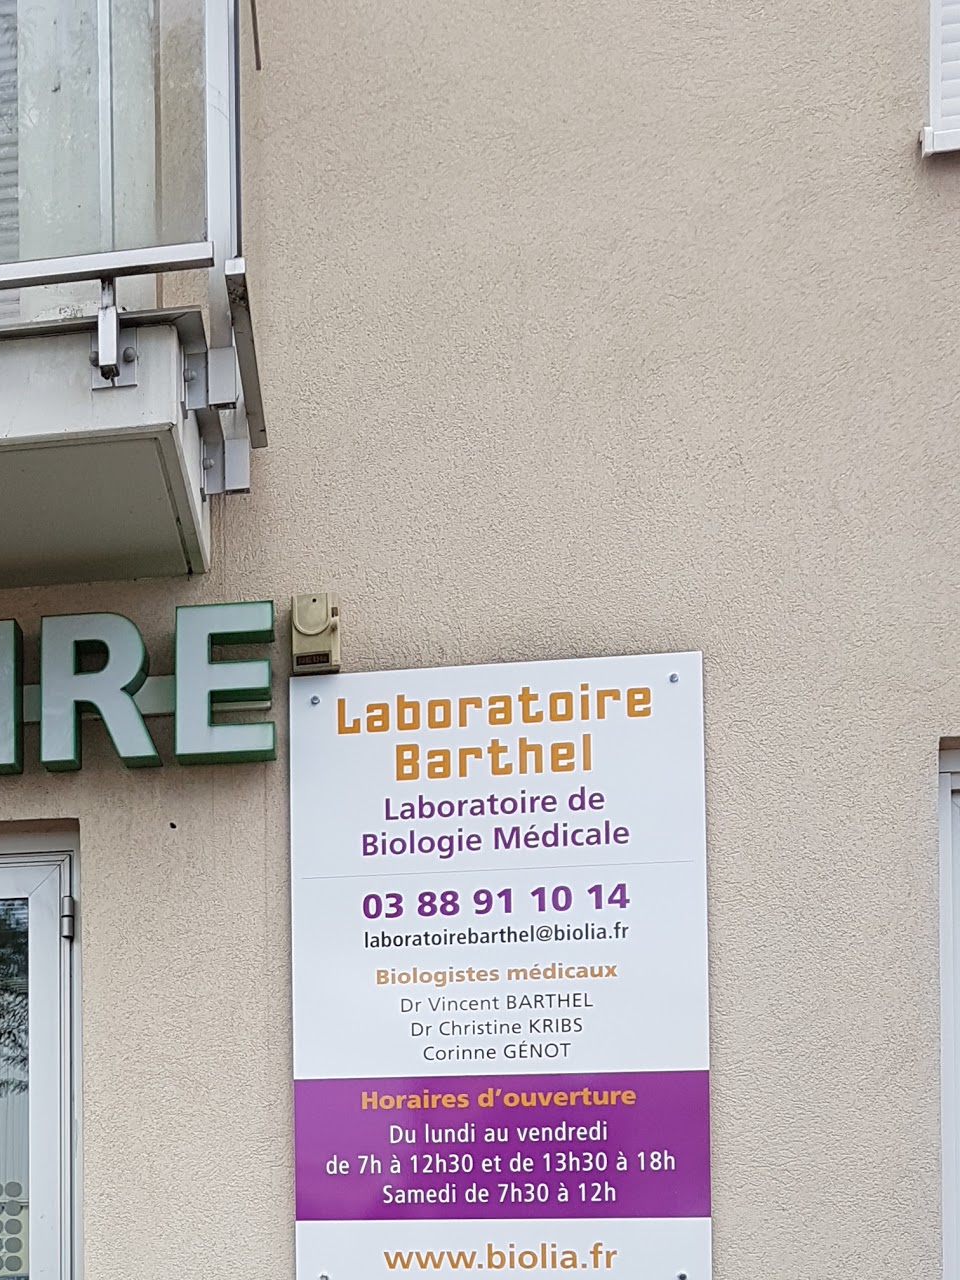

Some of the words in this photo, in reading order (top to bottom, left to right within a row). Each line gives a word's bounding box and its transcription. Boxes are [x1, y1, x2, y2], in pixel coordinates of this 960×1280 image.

[338, 683, 651, 734] Laboratoire
[396, 734, 591, 781] Barthel
[386, 790, 557, 820] Laboratoire
[569, 786, 604, 811] de
[363, 830, 482, 859] Biologie
[495, 821, 629, 849] Médicale
[363, 893, 403, 919] 03
[418, 891, 459, 916] 88
[474, 889, 511, 914] 91
[531, 886, 572, 912] 10
[588, 883, 630, 909] 14
[365, 922, 628, 948] laboratoirebarthel@biolia.fr
[377, 967, 499, 987] Biologistes
[508, 963, 617, 980] médicaux
[401, 999, 421, 1012] Dr
[428, 997, 499, 1011] Vincent
[507, 993, 593, 1009] BARTHEL
[412, 1023, 432, 1036] Dr
[440, 1020, 521, 1035] Christine
[530, 1018, 582, 1033] KRIBS
[424, 1047, 496, 1060] Corinne
[504, 1041, 571, 1058] GÉNOT
[362, 1088, 469, 1110] Horaires
[390, 1125, 415, 1143] Du
[426, 1123, 474, 1143] lundi
[484, 1128, 508, 1142] au
[517, 1121, 607, 1142] vendredi
[327, 1155, 349, 1175] de
[358, 1154, 381, 1173] 7h
[390, 1155, 400, 1173] à
[411, 1153, 474, 1173] 12h30
[482, 1156, 501, 1172] et
[510, 1152, 533, 1172] de
[543, 1151, 607, 1171] 13h30
[616, 1151, 627, 1170] à
[638, 1150, 675, 1170] 18h
[383, 1183, 456, 1203] Samedi
[465, 1183, 489, 1202] de
[498, 1183, 548, 1203] 7h30
[558, 1183, 568, 1201] à
[579, 1181, 615, 1201] 12h
[384, 1243, 617, 1269] www.biolia.fr
